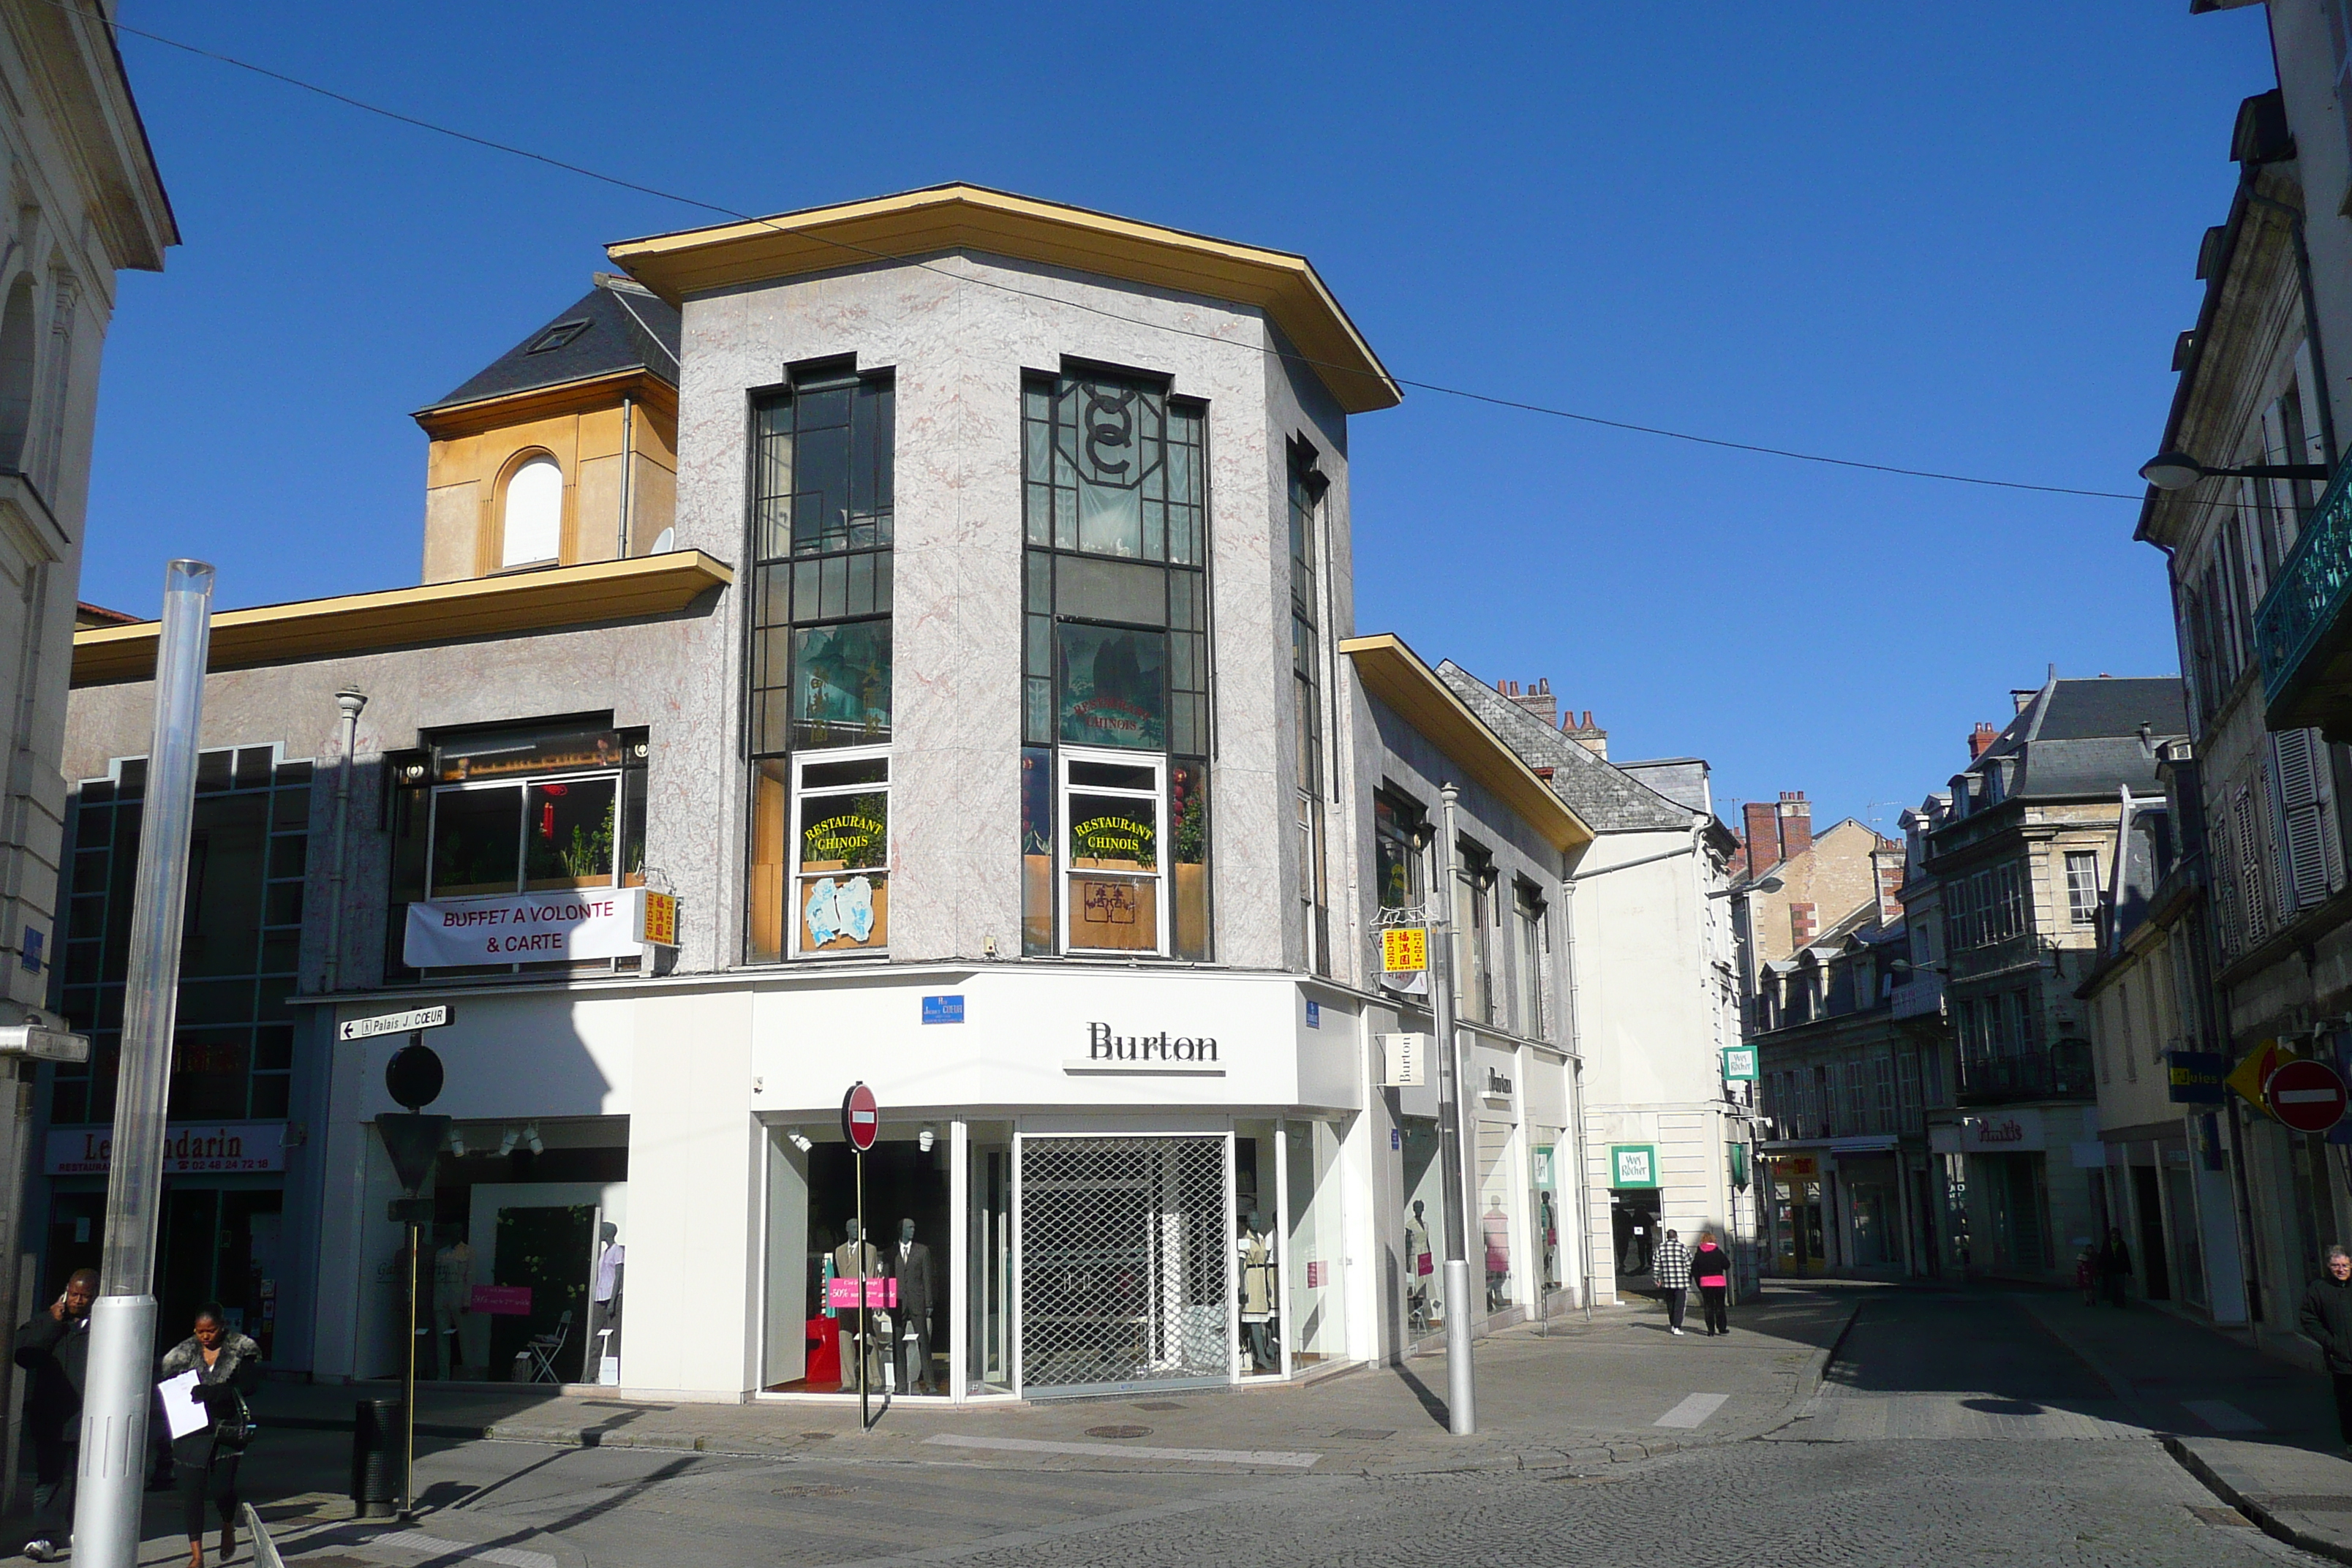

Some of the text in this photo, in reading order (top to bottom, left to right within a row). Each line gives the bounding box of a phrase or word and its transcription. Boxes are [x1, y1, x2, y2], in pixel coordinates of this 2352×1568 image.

[1073, 697, 1151, 721] RESTAURANT
[1086, 715, 1137, 731] CHINOIS
[804, 815, 883, 840] RESTAURANT
[1074, 816, 1153, 841] RESTAURANT
[818, 835, 868, 850] CHINOIS
[1088, 836, 1139, 851] CHINOIS
[443, 901, 614, 927] BUFFET A VOLONTE
[486, 933, 562, 953] & CARTE
[373, 1017, 399, 1032] Palais
[1086, 1021, 1221, 1062] Burton
[1399, 1037, 1411, 1082] Burton
[1730, 1061, 1752, 1071] Rocher
[1488, 1066, 1512, 1094] Burton
[2179, 1069, 2219, 1085] Jules
[84, 1128, 242, 1161] Le ndarin
[192, 1159, 268, 1169] 02 48 24 72 18
[1625, 1155, 1642, 1167] Yves
[1621, 1164, 1647, 1177] Rocher
[830, 1289, 848, 1298] -50%
